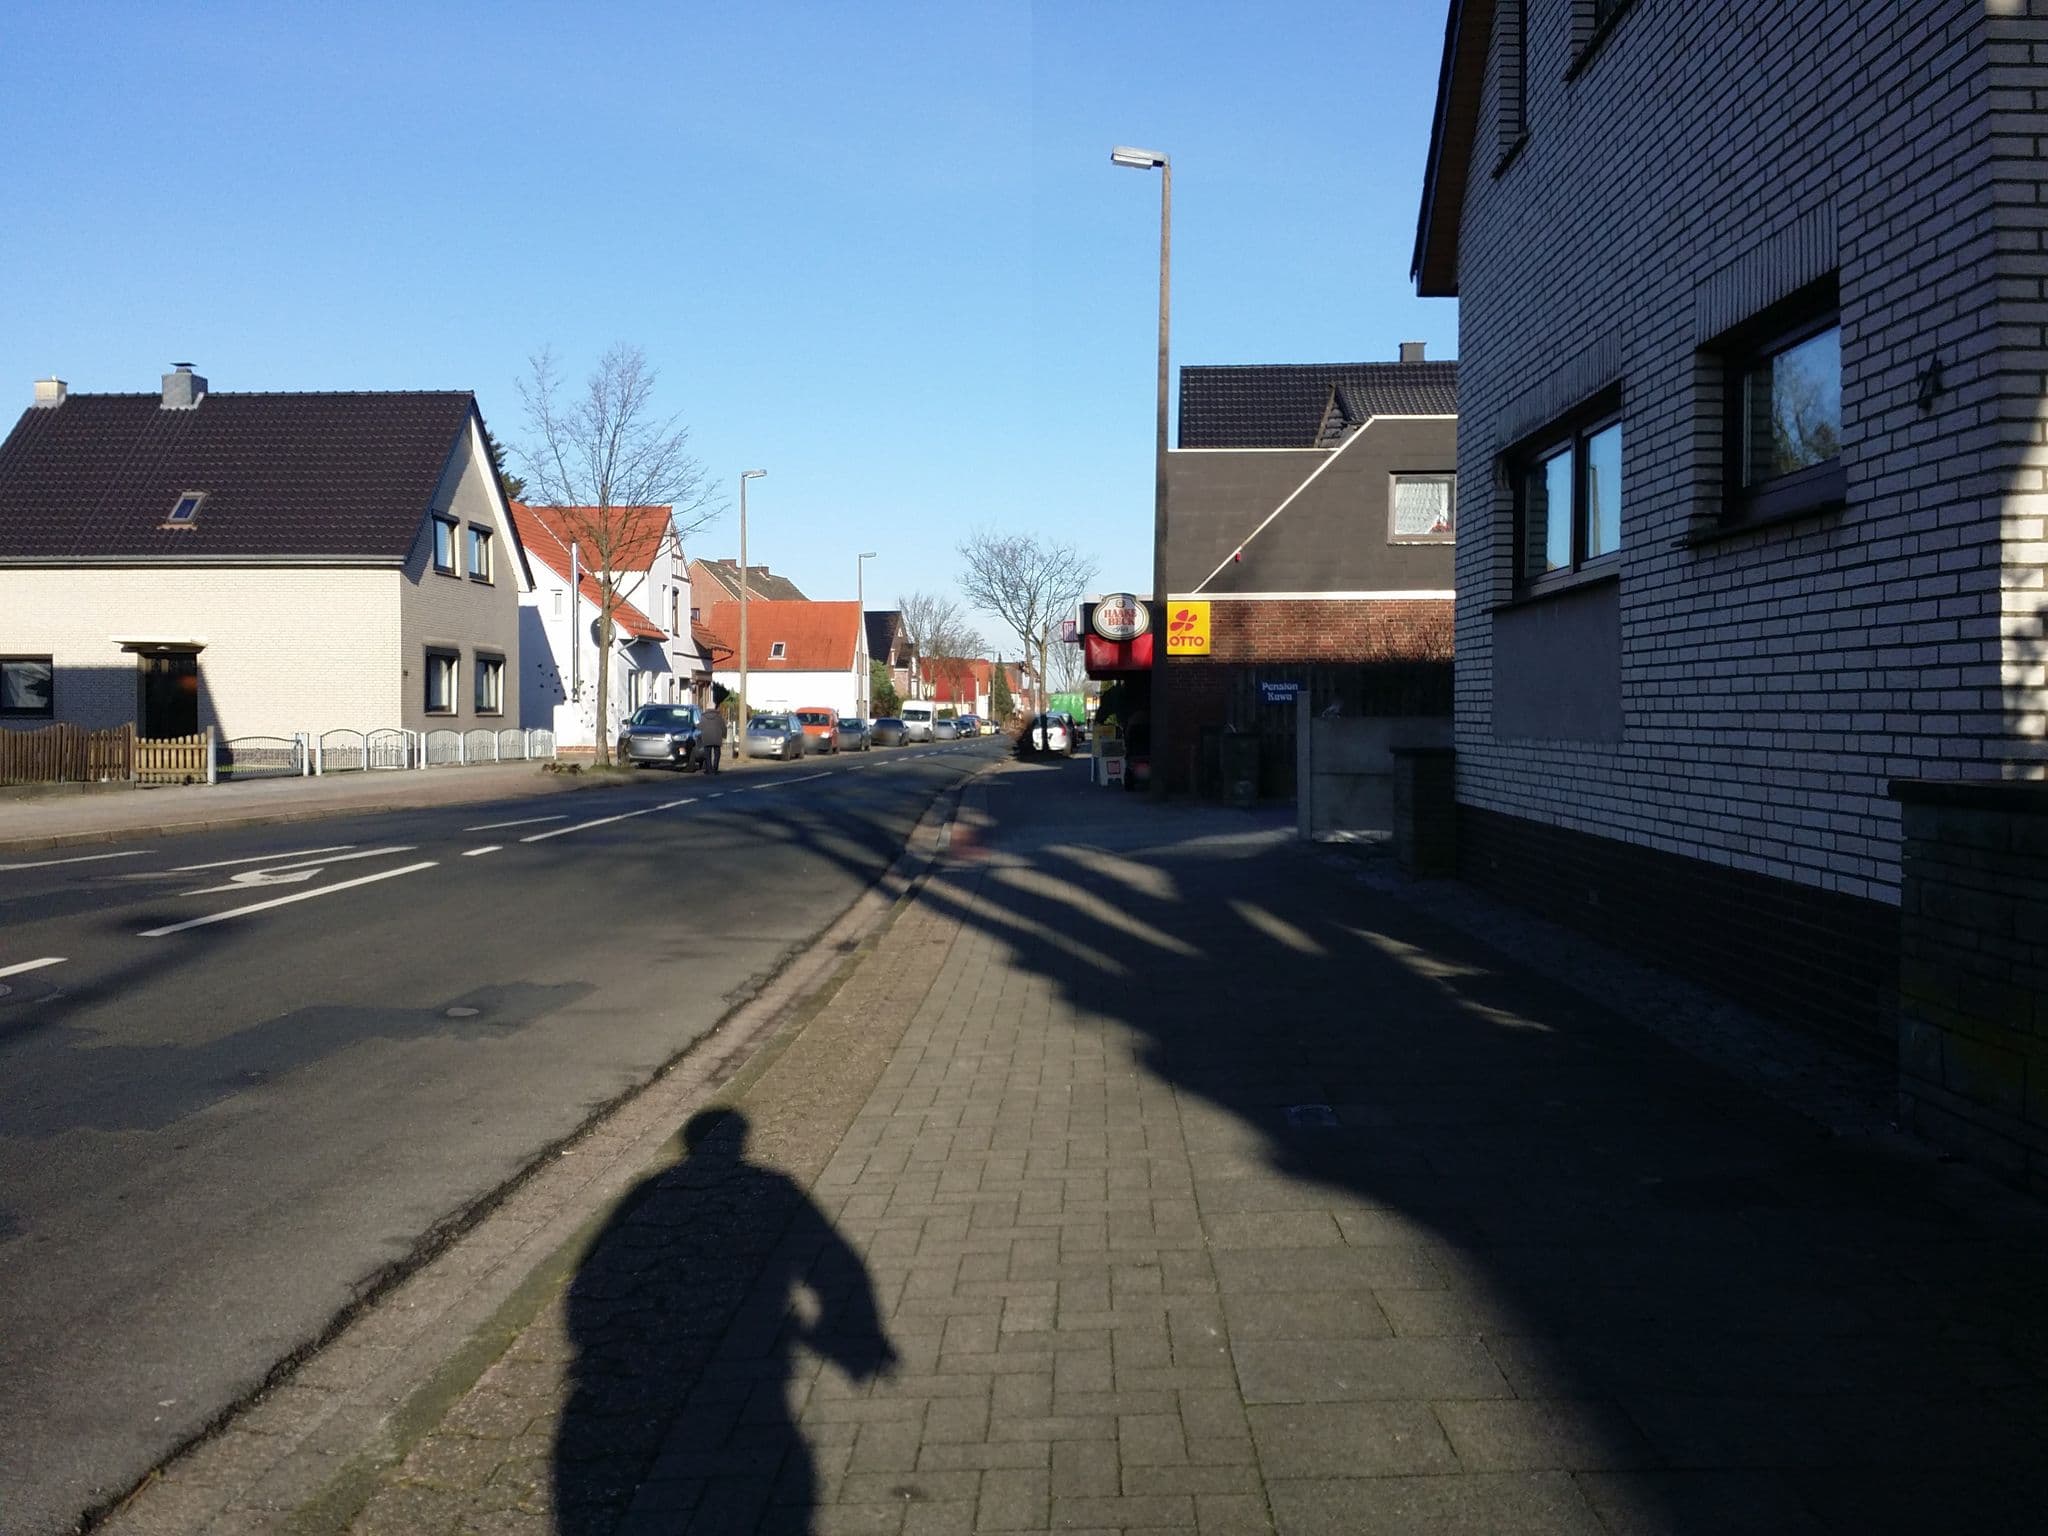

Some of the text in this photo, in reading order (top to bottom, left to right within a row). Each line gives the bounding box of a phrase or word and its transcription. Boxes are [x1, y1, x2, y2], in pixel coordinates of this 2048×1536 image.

[1108, 617, 1135, 626] BECK
[1167, 636, 1205, 647] OTTO
[1262, 681, 1298, 691] Pension
